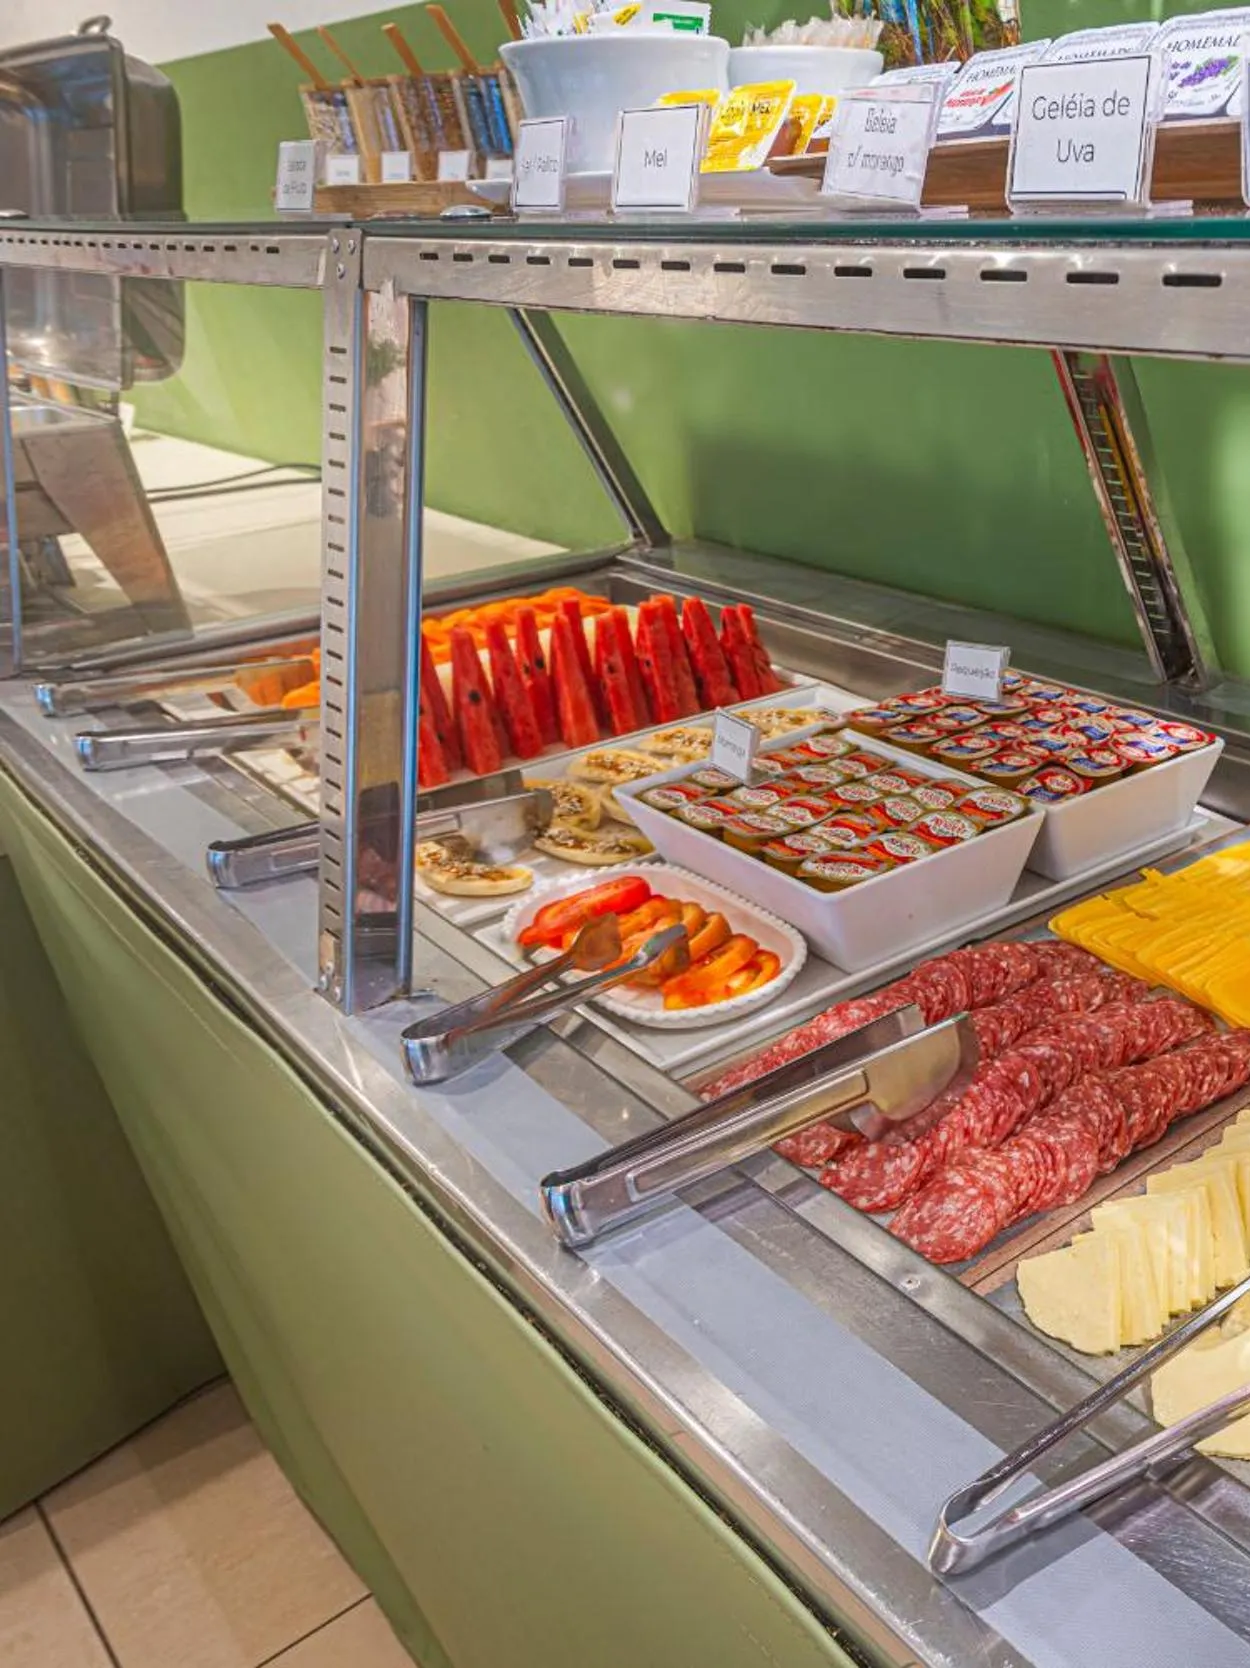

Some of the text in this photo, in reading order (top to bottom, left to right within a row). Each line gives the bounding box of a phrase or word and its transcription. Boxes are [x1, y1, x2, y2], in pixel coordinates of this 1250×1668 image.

[1031, 89, 1131, 121] Geléia de
[644, 149, 667, 168] Mel
[1056, 139, 1095, 163] Uva
